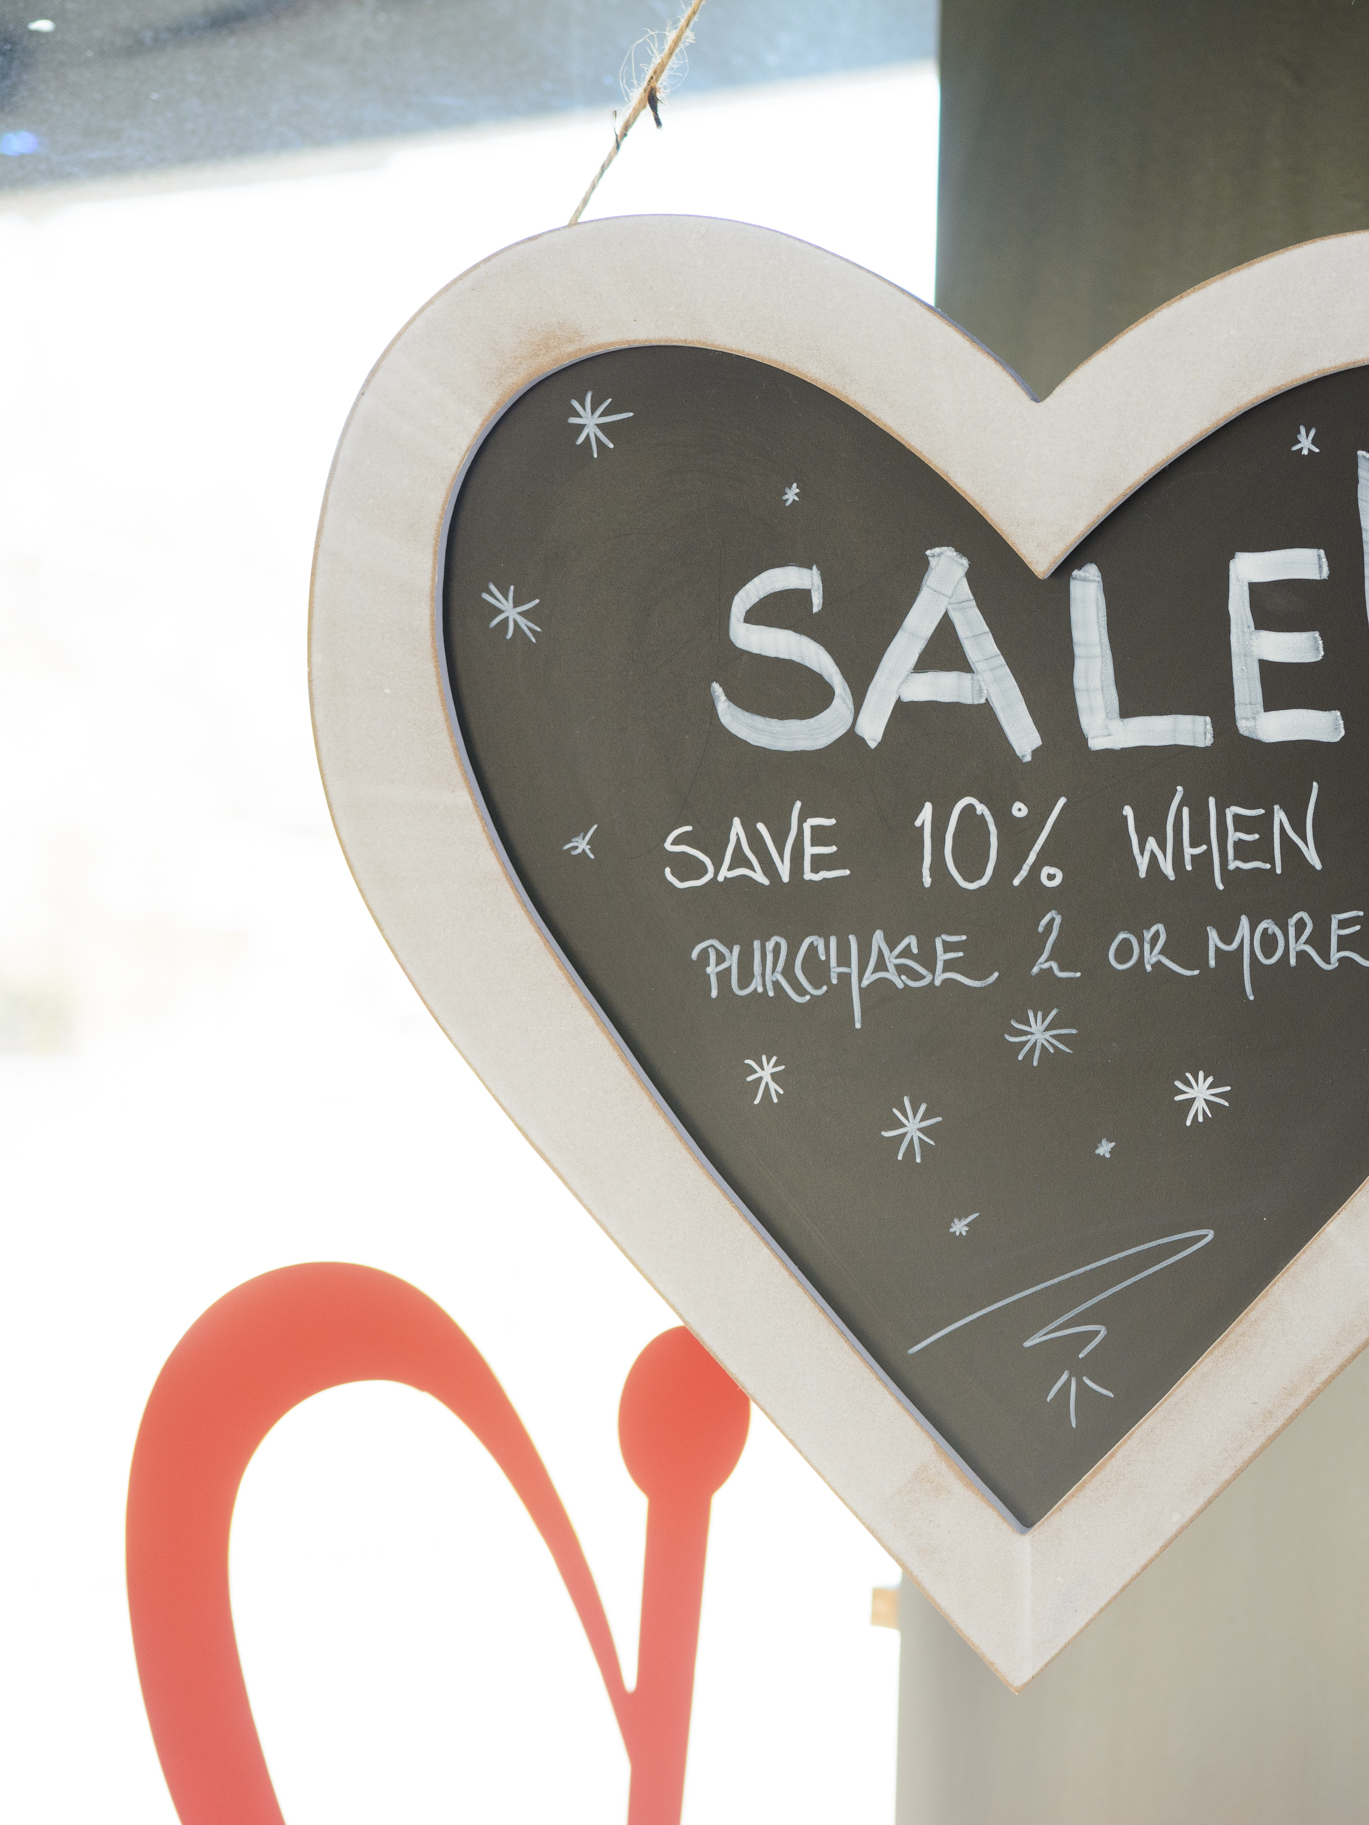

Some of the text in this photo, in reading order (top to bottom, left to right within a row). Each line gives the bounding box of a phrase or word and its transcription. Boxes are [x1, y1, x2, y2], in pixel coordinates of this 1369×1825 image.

[663, 799, 852, 890] SAVE
[913, 795, 1068, 891] 10%
[1122, 780, 1323, 891] WHEN
[690, 928, 1000, 1030] PURCHASE
[1030, 909, 1082, 979] 2
[1108, 922, 1201, 977] OR
